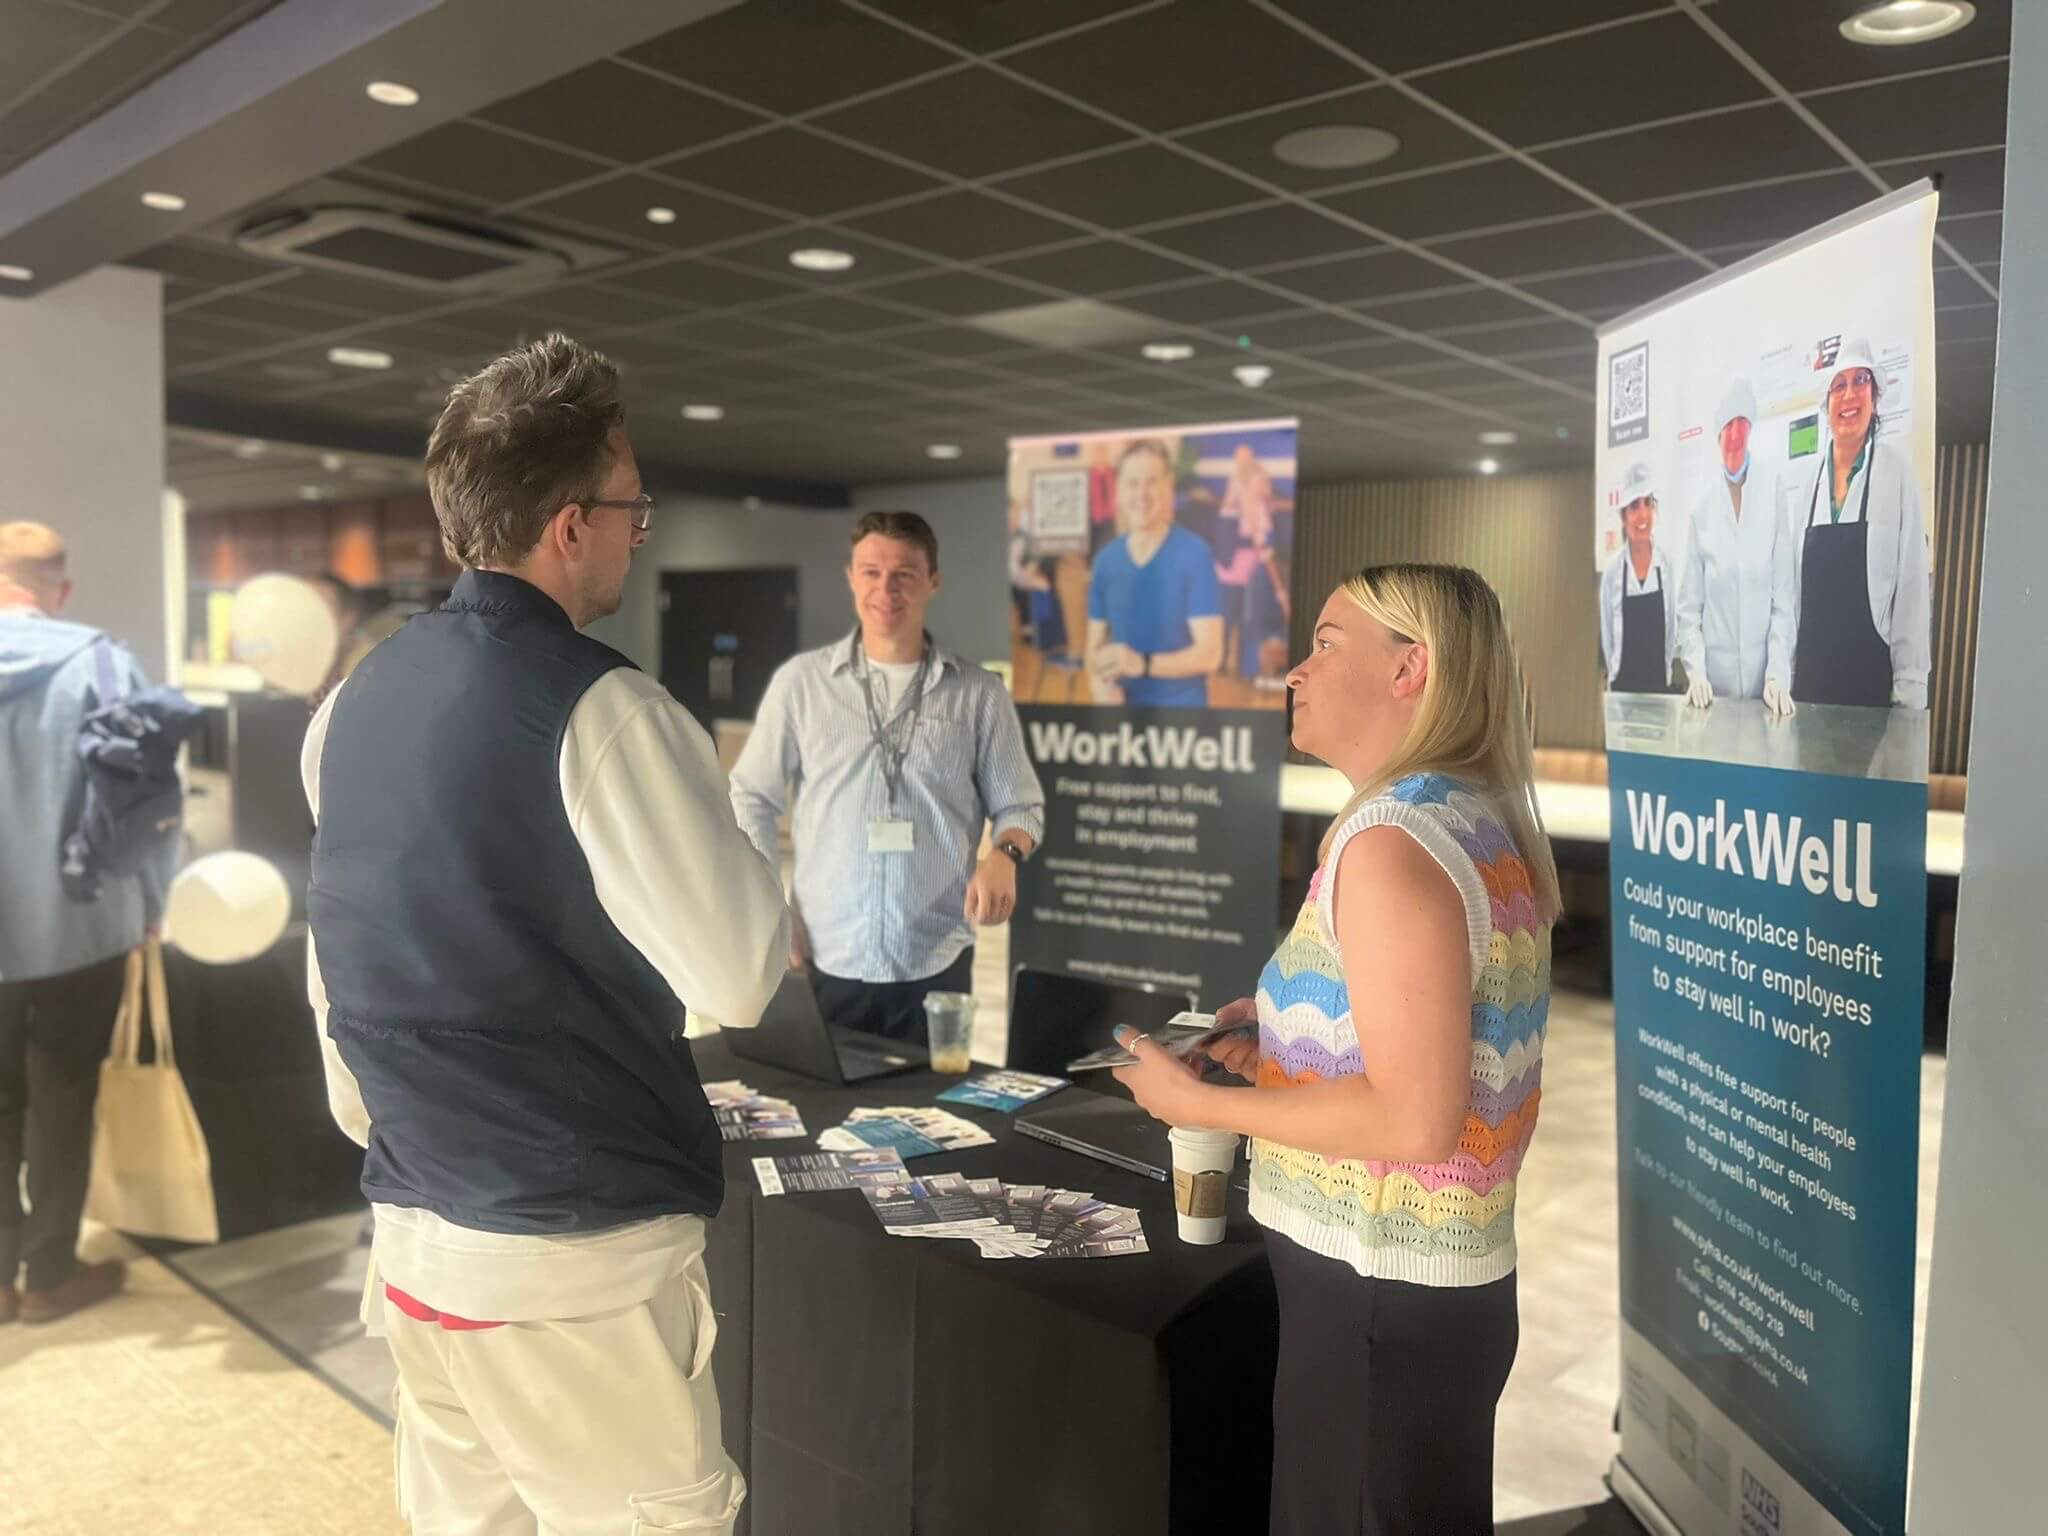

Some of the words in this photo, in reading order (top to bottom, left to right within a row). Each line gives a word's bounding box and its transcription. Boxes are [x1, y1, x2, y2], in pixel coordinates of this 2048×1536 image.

[1029, 721, 1255, 773] WorkWell
[1094, 781, 1156, 803] support
[1159, 783, 1180, 804] to
[1075, 824, 1093, 844] in
[1095, 828, 1198, 854] employment
[1076, 803, 1111, 826] stay
[1113, 805, 1145, 825] and
[1147, 806, 1198, 829] thrive
[1626, 788, 1878, 908] WorkWell
[1623, 876, 1663, 909] Could
[1666, 892, 1703, 919] your
[1706, 901, 1799, 952] workplace
[1805, 926, 1883, 979] benefit
[1628, 914, 1661, 949] from
[1665, 932, 1727, 973] support
[1730, 949, 1757, 983] for
[1762, 967, 1872, 1026] employees
[1652, 964, 1670, 991] to
[1674, 973, 1706, 1012] stay
[1709, 990, 1744, 1024] well
[1748, 1001, 1766, 1032] in
[1771, 1014, 1832, 1059] work?
[1637, 1027, 1685, 1063] WorkWell
[1686, 1050, 1713, 1072] offers
[1715, 1065, 1738, 1090] free
[1740, 1080, 1789, 1116] support
[1790, 1101, 1810, 1126] for
[1812, 1115, 1857, 1152] people
[1655, 1063, 1679, 1087] with
[1680, 1076, 1688, 1092] a
[1689, 1079, 1729, 1117] physical
[1730, 1106, 1743, 1123] or
[1746, 1113, 1789, 1149] mental
[1791, 1133, 1832, 1173] health
[1638, 1082, 1688, 1122] condition,
[1689, 1110, 1707, 1133] and
[1707, 1122, 1727, 1144] can
[1729, 1133, 1756, 1162] help
[1757, 1151, 1785, 1177] your
[1787, 1167, 1857, 1222] employees
[1685, 1135, 1697, 1155] to
[1698, 1144, 1718, 1173] stay
[1719, 1157, 1744, 1186] well
[1745, 1171, 1757, 1193] in
[1759, 1181, 1795, 1216] work.
[1724, 1208, 1755, 1240] team
[1757, 1230, 1771, 1249] to
[1773, 1237, 1799, 1269] find
[1800, 1261, 1824, 1288] out
[1826, 1278, 1864, 1316] more.
